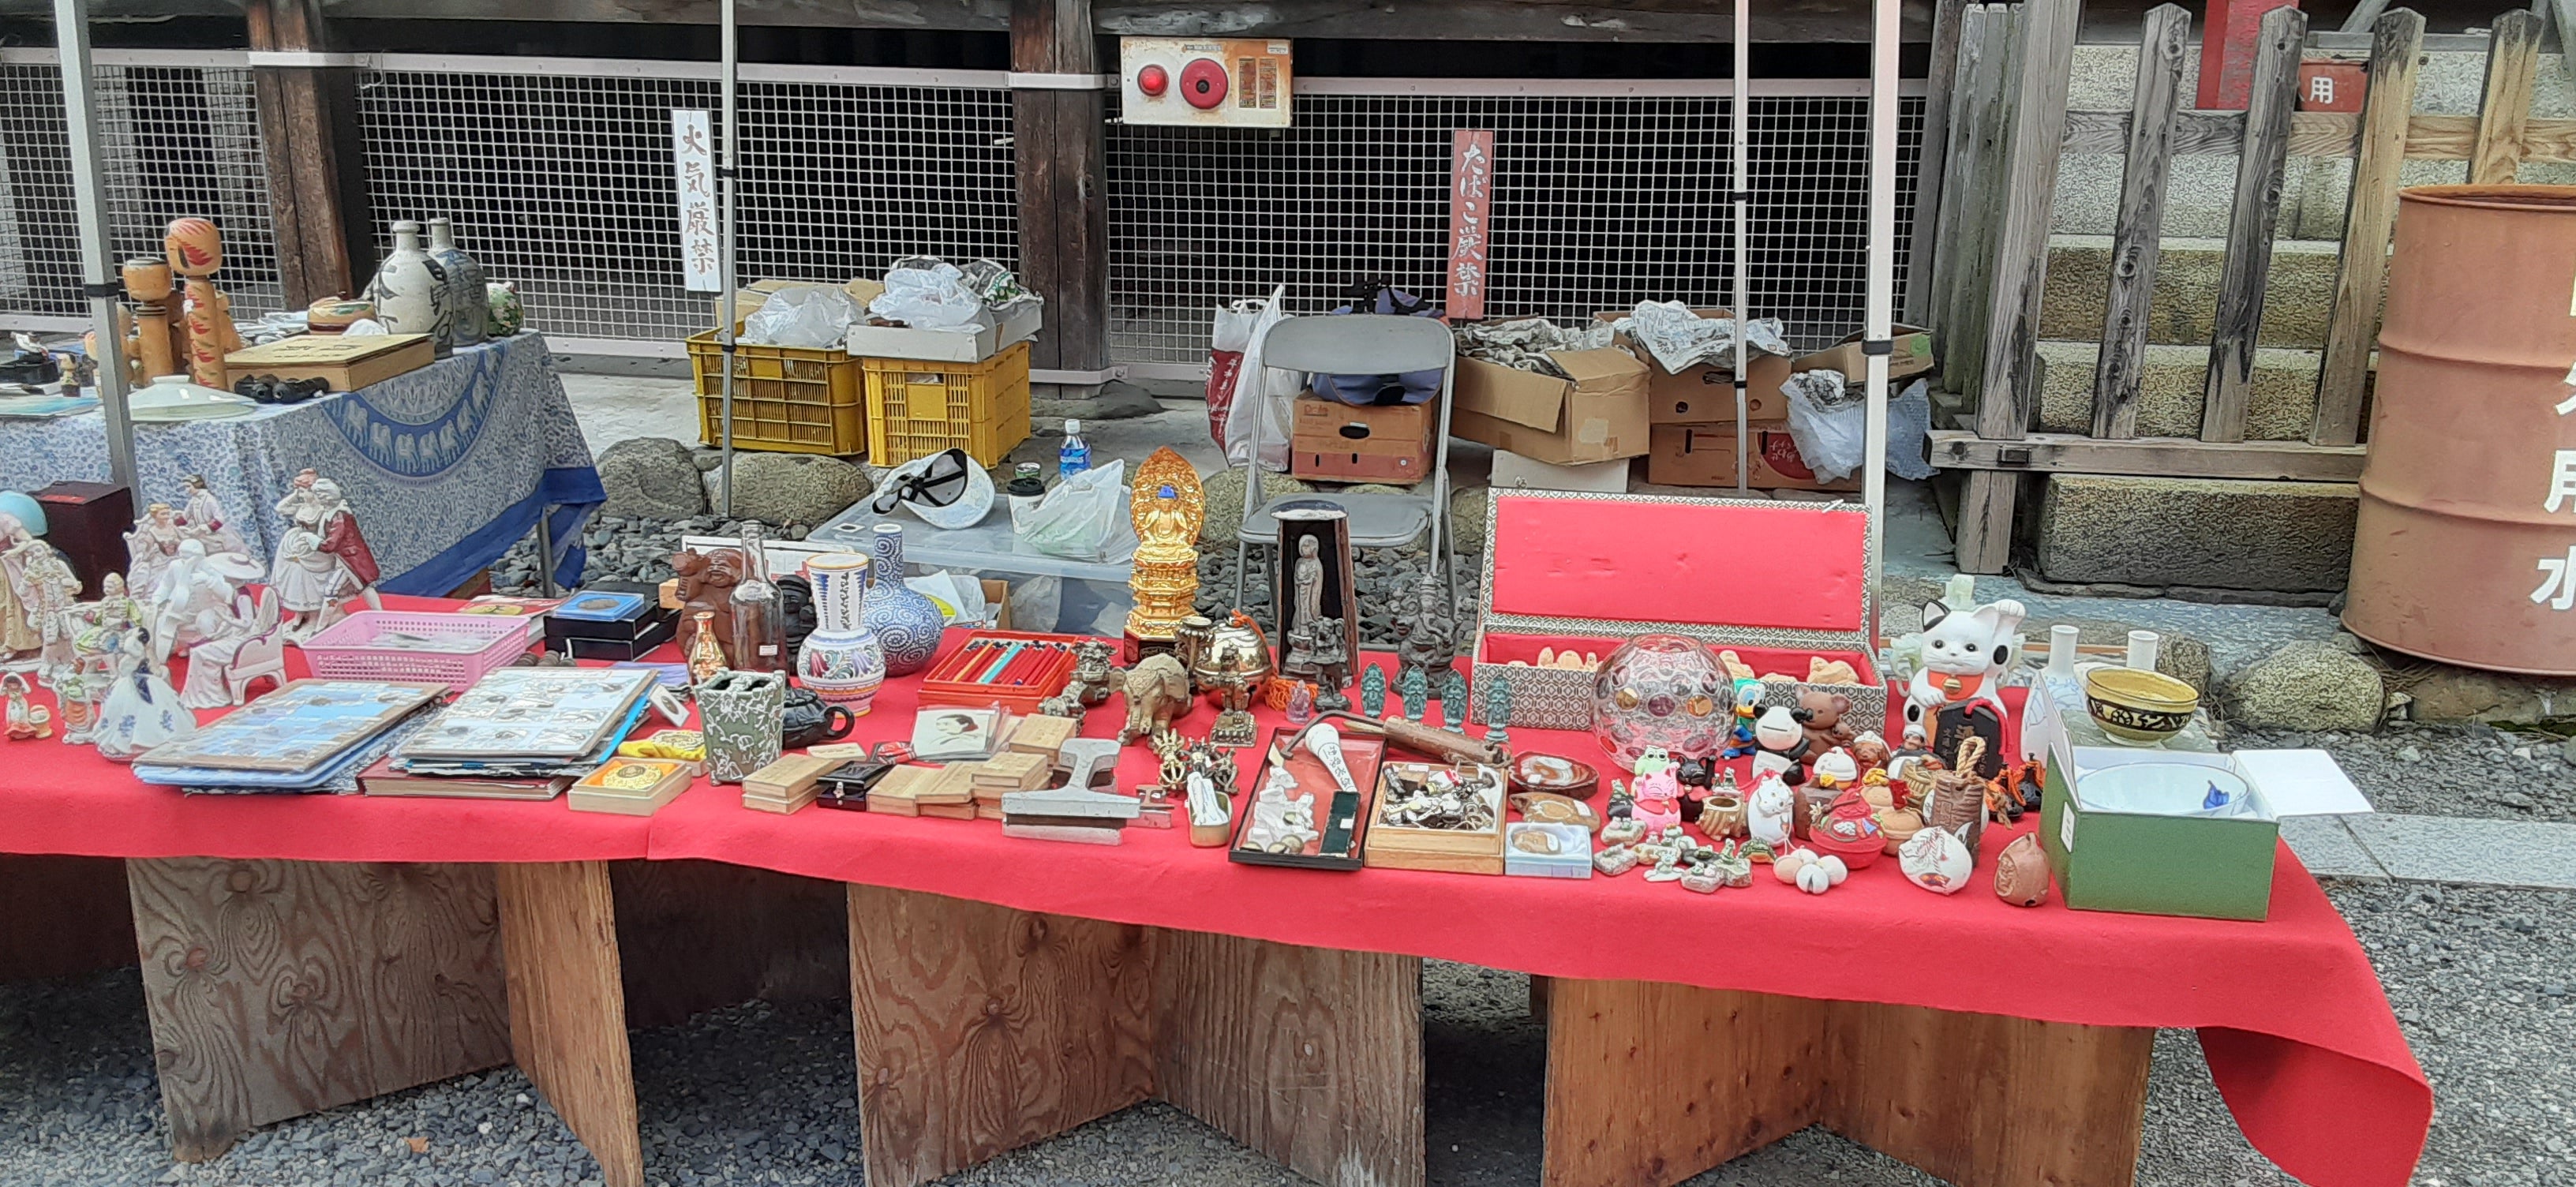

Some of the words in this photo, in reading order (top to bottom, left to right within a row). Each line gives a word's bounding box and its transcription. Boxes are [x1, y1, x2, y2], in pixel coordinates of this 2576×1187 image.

[2297, 76, 2334, 104] 用
[681, 123, 715, 275] 火気厳禁
[1451, 143, 1489, 298] たばこ厳禁
